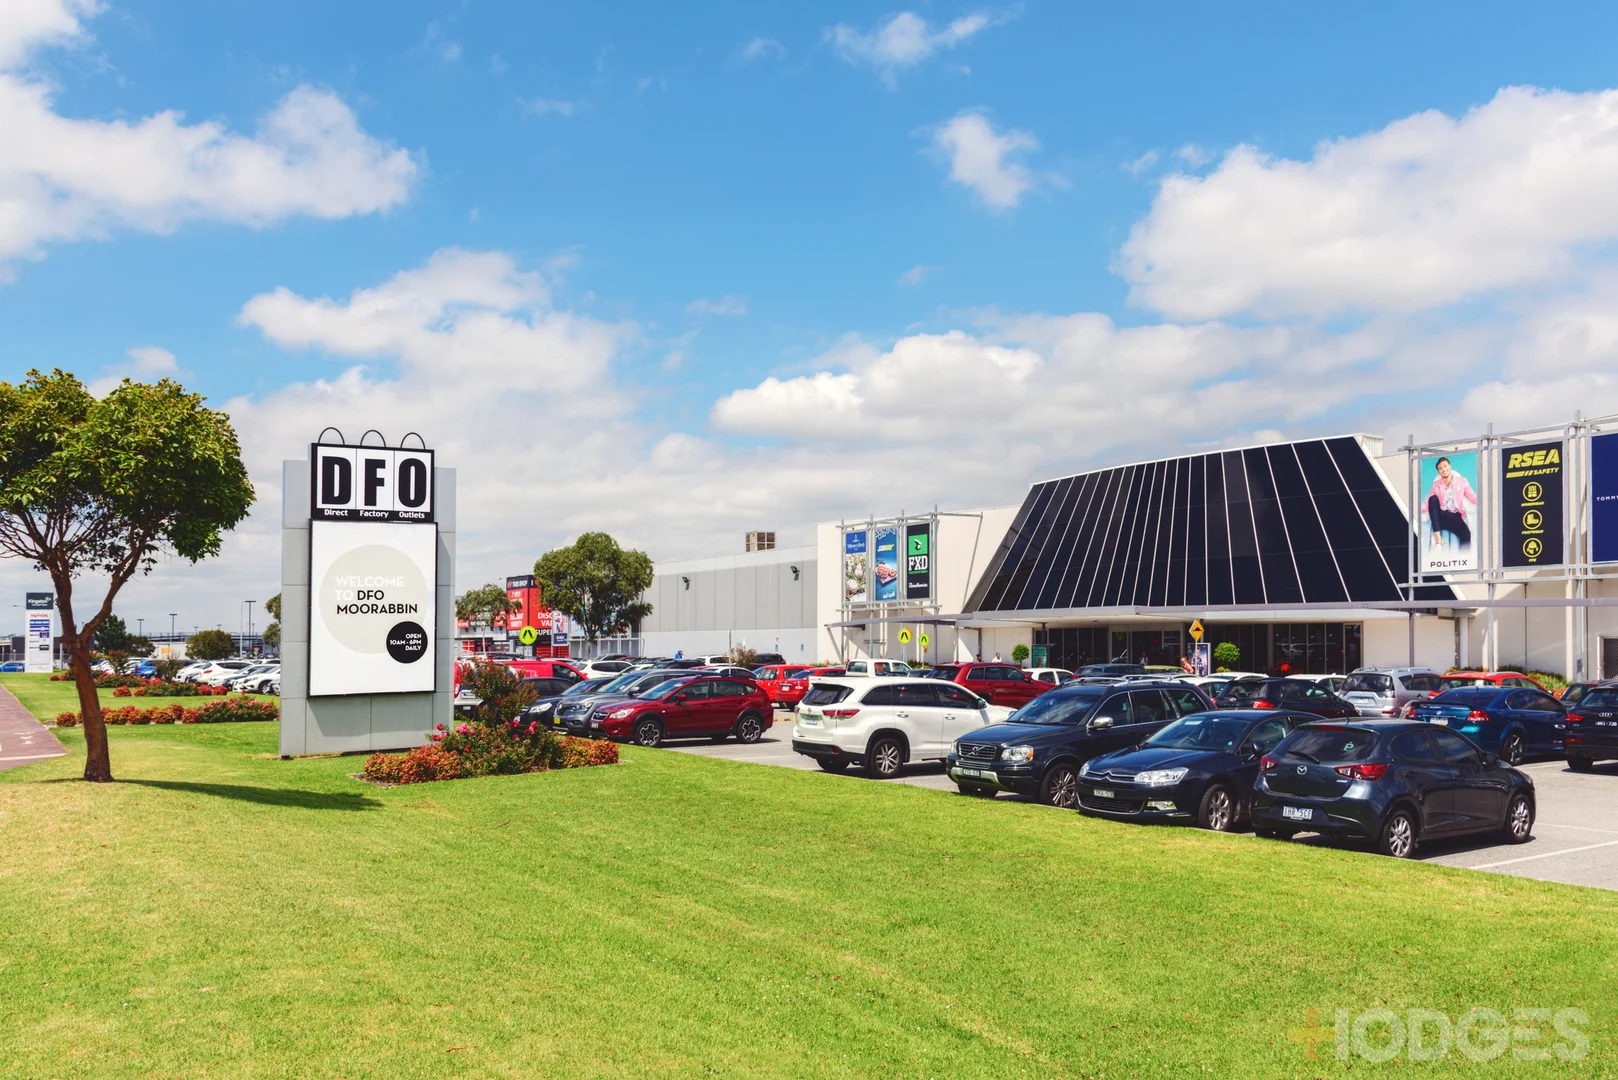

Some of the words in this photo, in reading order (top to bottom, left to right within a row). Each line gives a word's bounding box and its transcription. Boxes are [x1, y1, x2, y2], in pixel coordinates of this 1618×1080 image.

[1508, 449, 1560, 469] RSEA
[1533, 467, 1560, 475] SAFETY
[322, 456, 427, 508] DFO
[360, 510, 389, 518] Factory
[1430, 559, 1468, 568] POLITIX
[335, 576, 404, 588] WELCOME
[335, 589, 354, 601] TO
[357, 590, 385, 601] DFO
[336, 603, 418, 615] MOORABBIN
